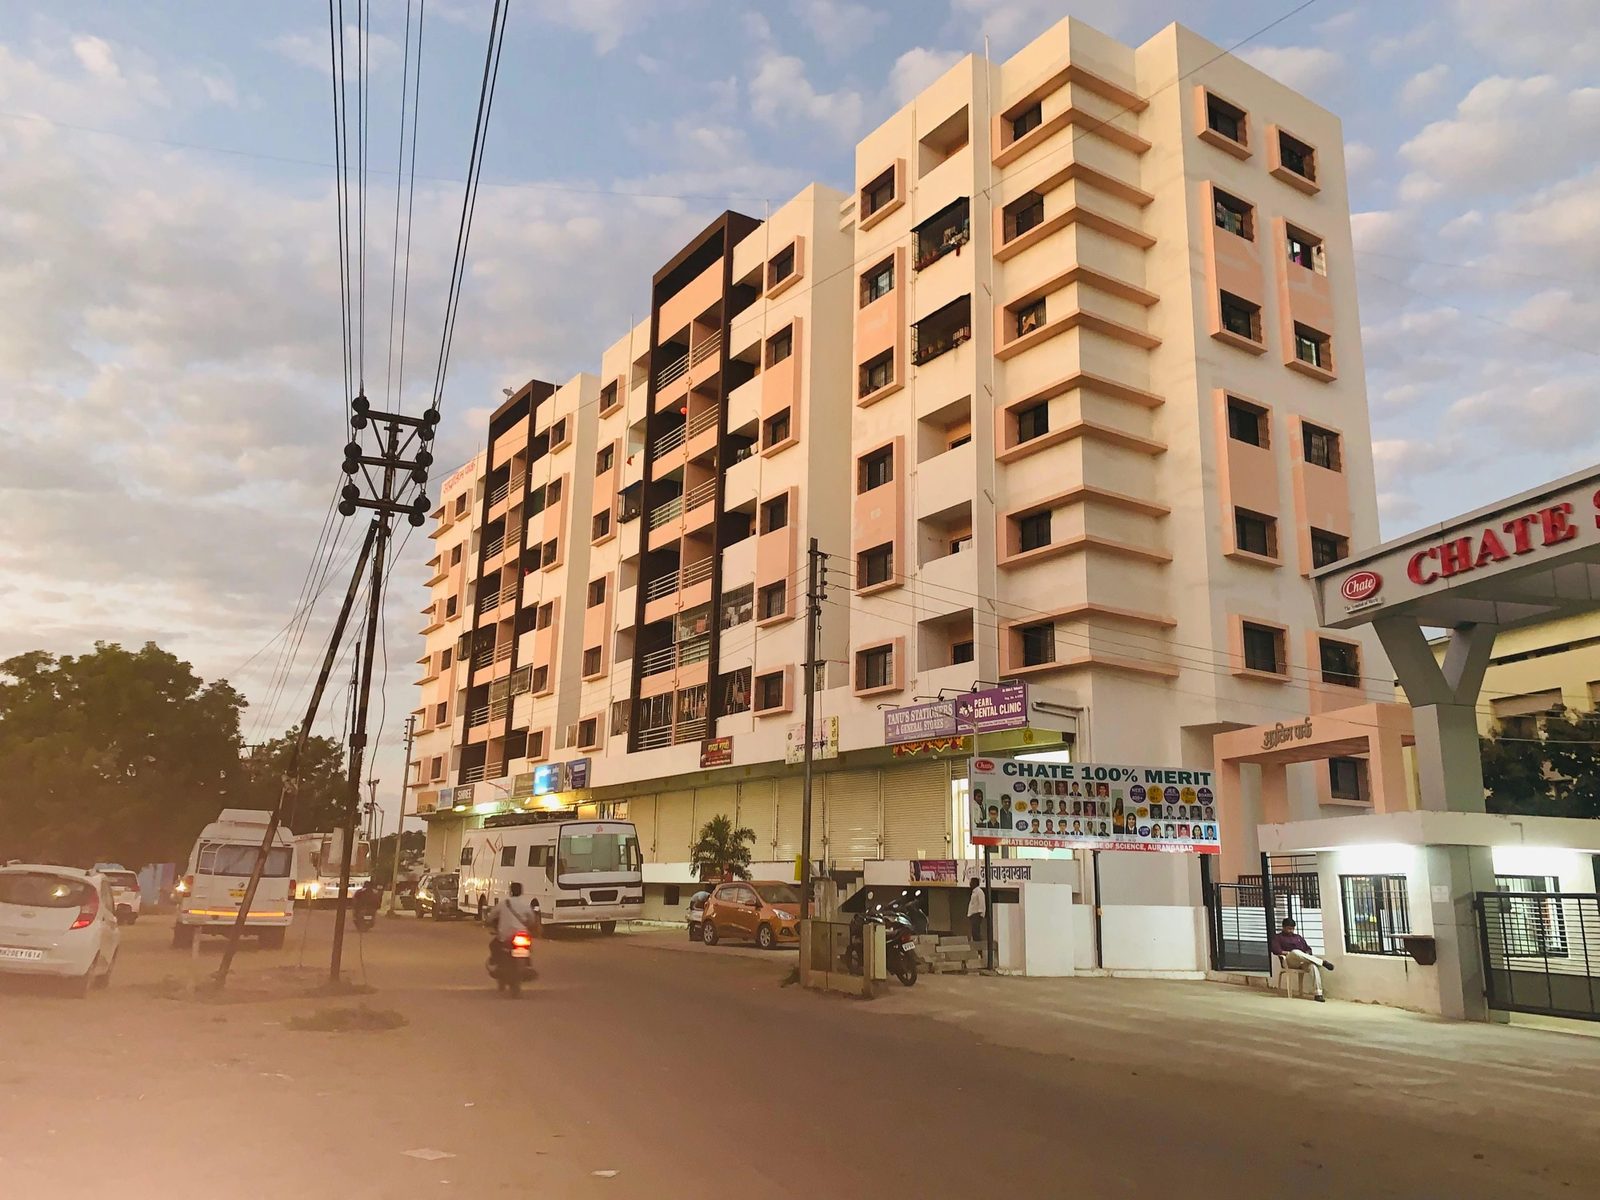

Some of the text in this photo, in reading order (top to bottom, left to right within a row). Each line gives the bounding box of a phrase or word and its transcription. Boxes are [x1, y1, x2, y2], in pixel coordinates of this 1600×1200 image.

[1407, 502, 1578, 585] CHATE
[1346, 578, 1374, 595] Chate
[974, 697, 993, 708] PEARL
[974, 702, 1022, 719] DENTAL CLINIC
[887, 710, 911, 725] TANU'S
[900, 721, 924, 734] GENERAL
[1002, 762, 1211, 786] CHATE 100% MERIT
[1001, 838, 1023, 846] CHATE
[1024, 839, 1053, 847] SCHOOL
[1115, 843, 1147, 851] SCIENCE,
[1147, 844, 1193, 853] AURANGABAD
